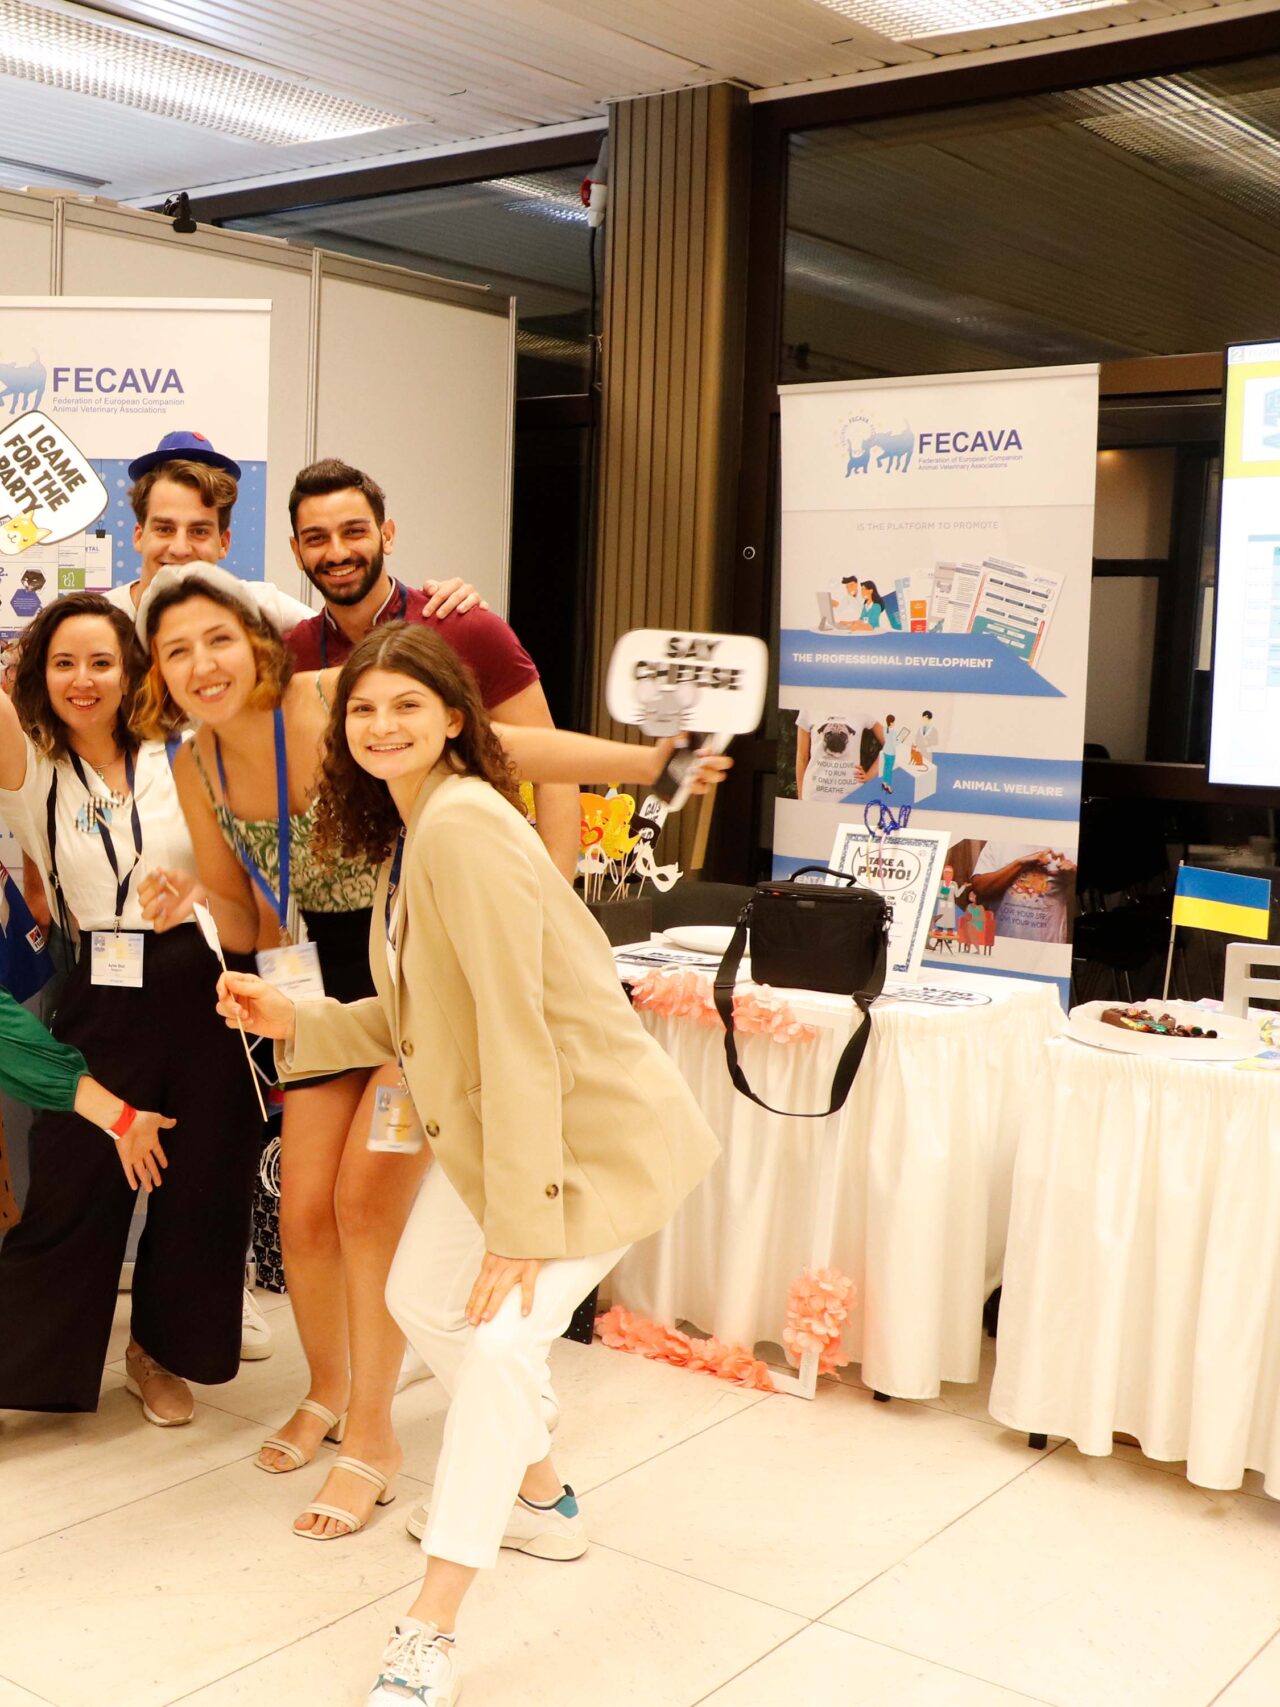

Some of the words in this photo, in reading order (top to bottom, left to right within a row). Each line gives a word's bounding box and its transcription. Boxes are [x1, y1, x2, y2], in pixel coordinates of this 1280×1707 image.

[52, 367, 185, 394] FECAVA
[53, 397, 94, 406] Federation
[96, 397, 103, 405] of
[104, 397, 140, 408] European
[142, 398, 185, 408] Companion
[53, 405, 78, 414] Animal
[81, 405, 118, 416] Veterinary
[119, 406, 167, 415] Associations
[28, 424, 45, 440] I
[919, 429, 1023, 455] FECAVA
[36, 434, 87, 494] CAME
[3, 434, 36, 476] FOR
[33, 469, 72, 512] THE
[867, 523, 884, 531] THE
[887, 522, 935, 531] PLATFORM
[939, 522, 951, 530] TO
[953, 521, 999, 530] PROMOTE
[667, 636, 721, 660] SAY
[792, 652, 813, 663] THE
[815, 653, 902, 666] PROFESSIONAL
[905, 655, 993, 669] DEVELOPMENT
[953, 779, 1000, 793] ANIMAL
[1003, 782, 1064, 798] WELFARE
[869, 856, 894, 868] TAKE
[897, 859, 905, 868] A
[857, 865, 912, 881] PHOTO!
